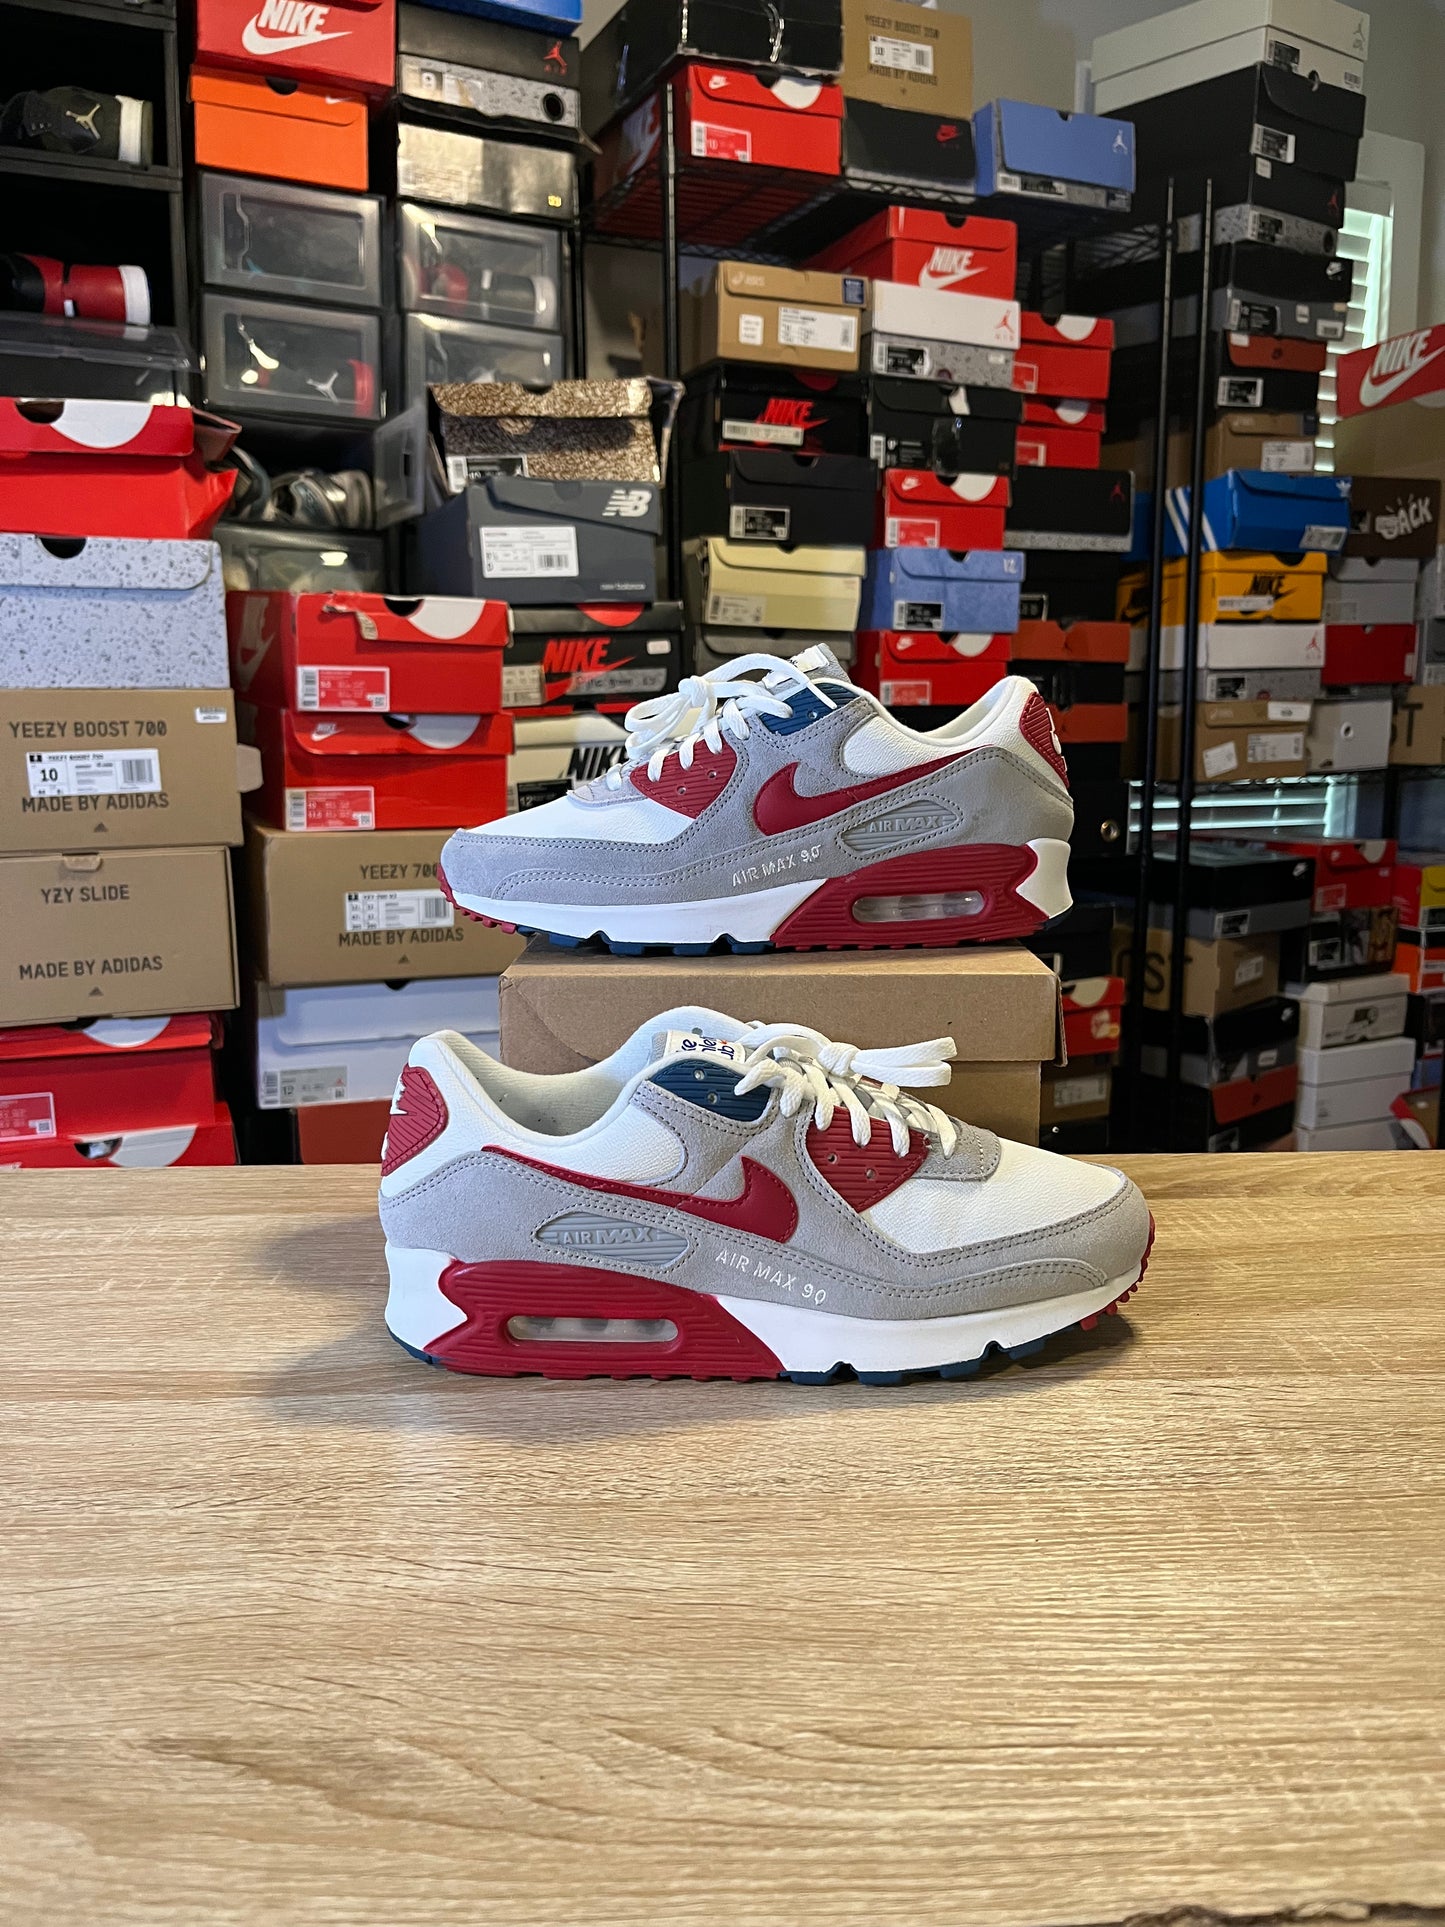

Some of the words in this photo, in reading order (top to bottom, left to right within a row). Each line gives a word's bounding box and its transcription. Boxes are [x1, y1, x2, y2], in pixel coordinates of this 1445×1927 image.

[257, 0, 330, 36] NIKE
[929, 246, 974, 274] NIKE
[1371, 329, 1433, 377] NIKE
[763, 397, 814, 427] NIKE
[544, 638, 611, 674] NIKE
[9, 721, 67, 738] YEEZY
[74, 720, 130, 737] BOOST
[134, 720, 167, 737] 700
[40, 768, 58, 782] 10
[22, 796, 72, 813] MADE
[79, 795, 100, 811] BY
[106, 793, 169, 810] ADIDAS
[869, 820, 892, 833] AIR
[894, 816, 939, 831] MAX
[360, 863, 408, 880] YEEZY
[731, 868, 760, 887] AIR
[761, 854, 797, 876] MAX
[800, 844, 822, 863] 90
[41, 888, 74, 904] YZY
[80, 884, 130, 902] SLIDE
[338, 931, 382, 947] MADE
[386, 930, 406, 945] BY
[410, 928, 464, 943] ADIDAS
[19, 962, 69, 980] MADE
[74, 959, 95, 977] BY
[101, 955, 163, 975] ADIDAS
[563, 1231, 593, 1244] AIR
[596, 1227, 653, 1244] MAX
[715, 1248, 750, 1273] AIR
[753, 1261, 797, 1291] MAX
[801, 1283, 827, 1306] 90
